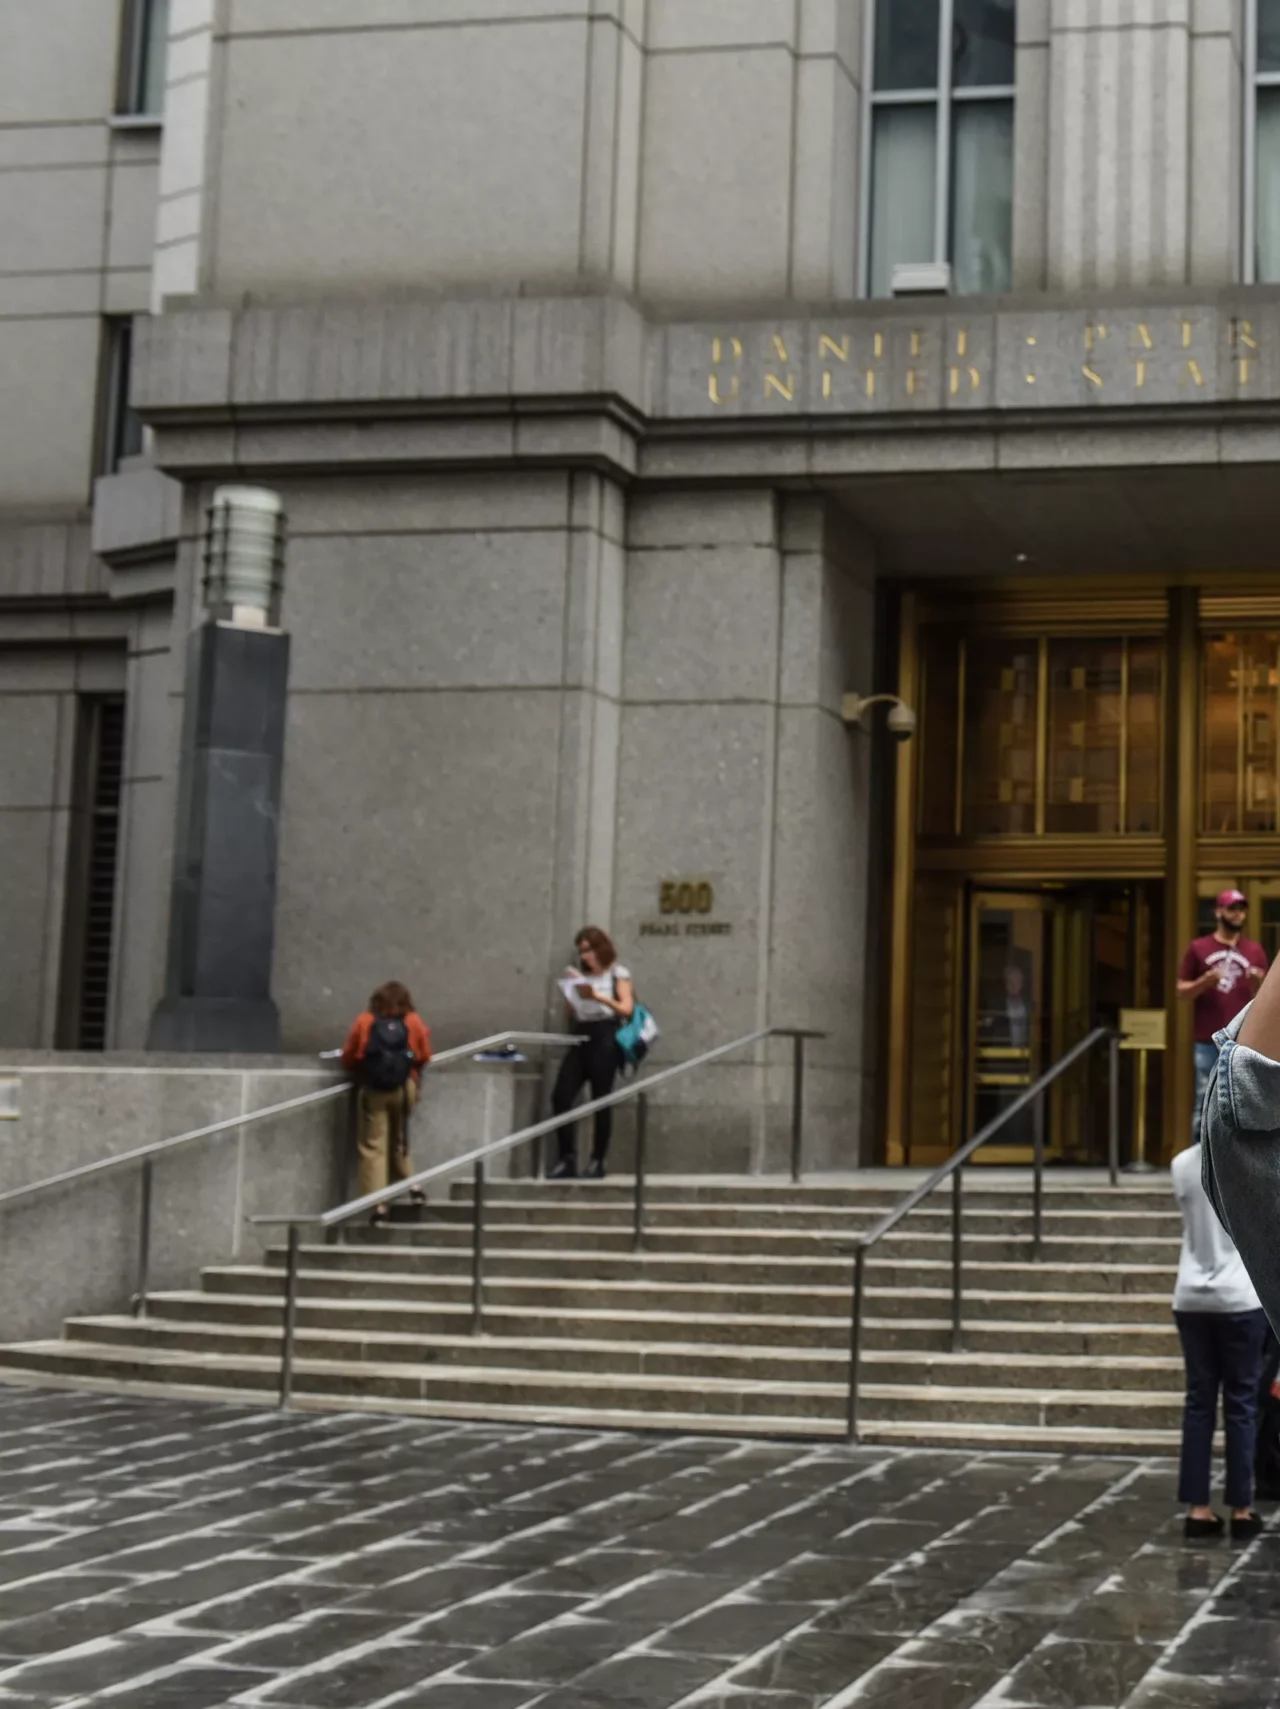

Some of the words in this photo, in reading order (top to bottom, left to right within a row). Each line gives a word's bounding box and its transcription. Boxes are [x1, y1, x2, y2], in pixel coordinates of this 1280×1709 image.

[711, 328, 976, 363] DANIEL
[708, 366, 979, 404] UNITED
[660, 881, 713, 914] 500
